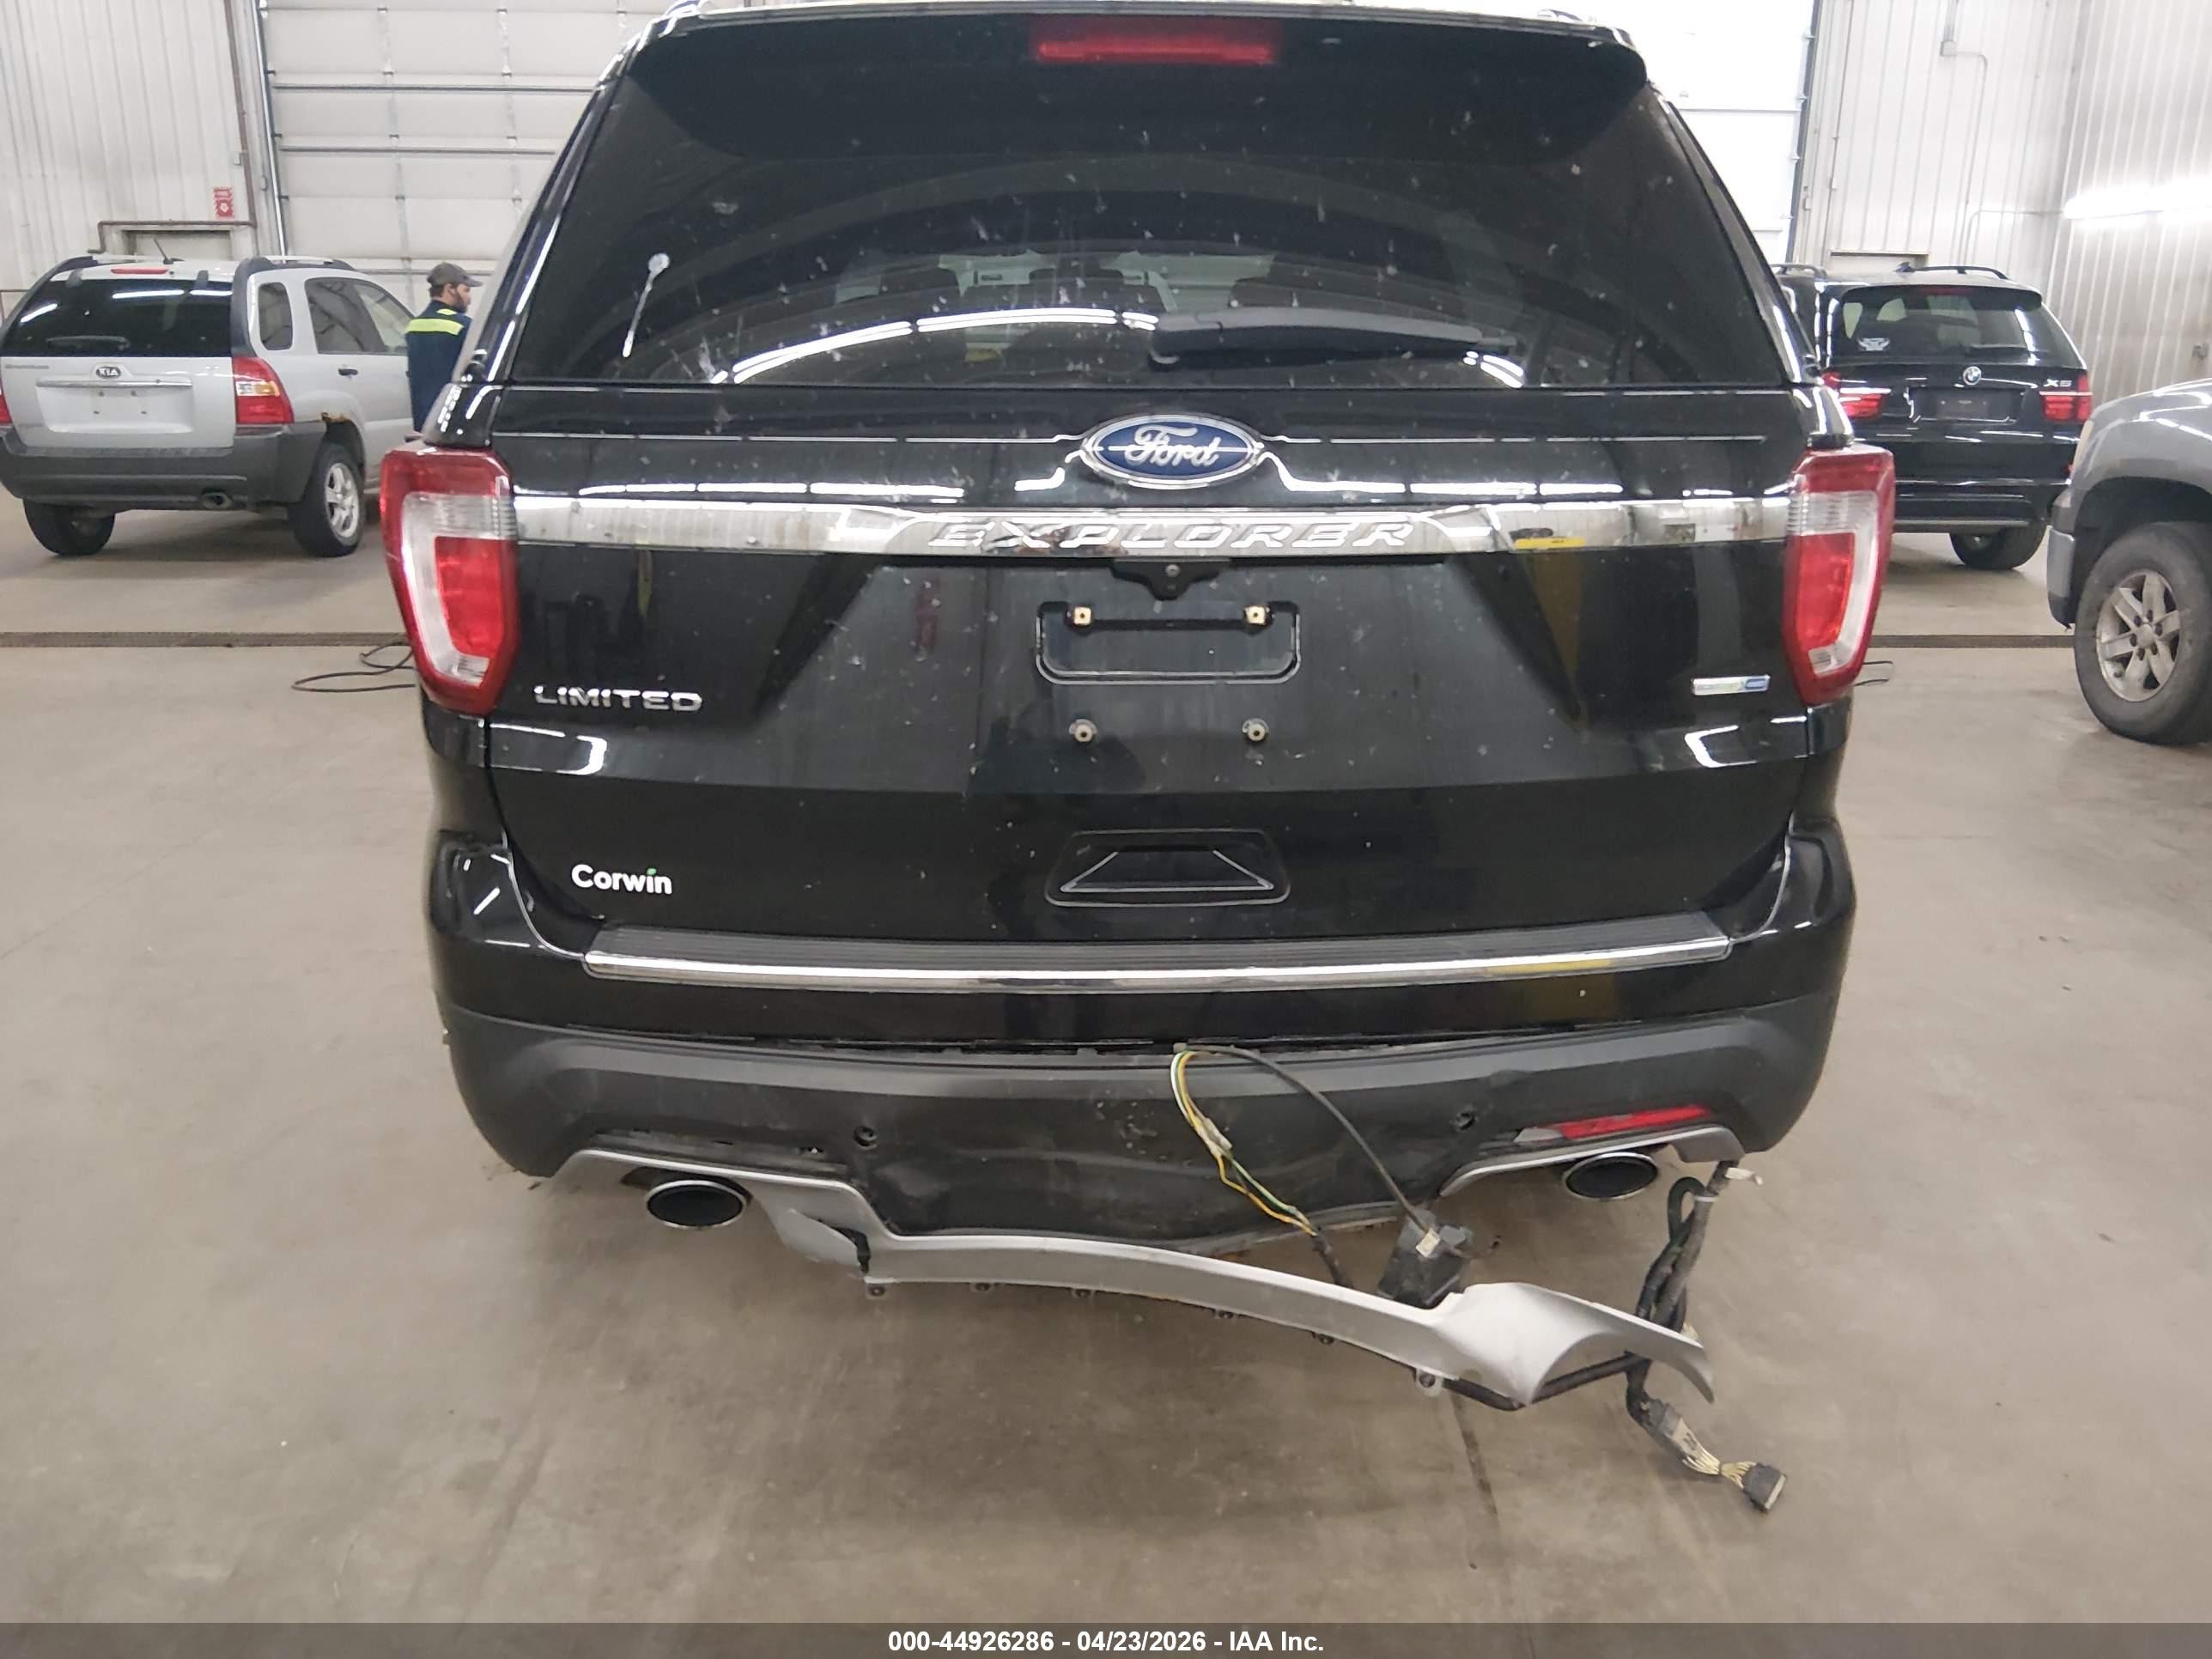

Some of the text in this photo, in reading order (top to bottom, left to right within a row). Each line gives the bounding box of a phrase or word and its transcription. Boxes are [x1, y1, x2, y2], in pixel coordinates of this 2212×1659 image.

[2043, 378, 2073, 387] X5
[1124, 424, 1221, 467] Ford
[927, 520, 1415, 549] EXPLORER
[533, 685, 703, 712] LIMITED
[571, 864, 673, 895] Corwin
